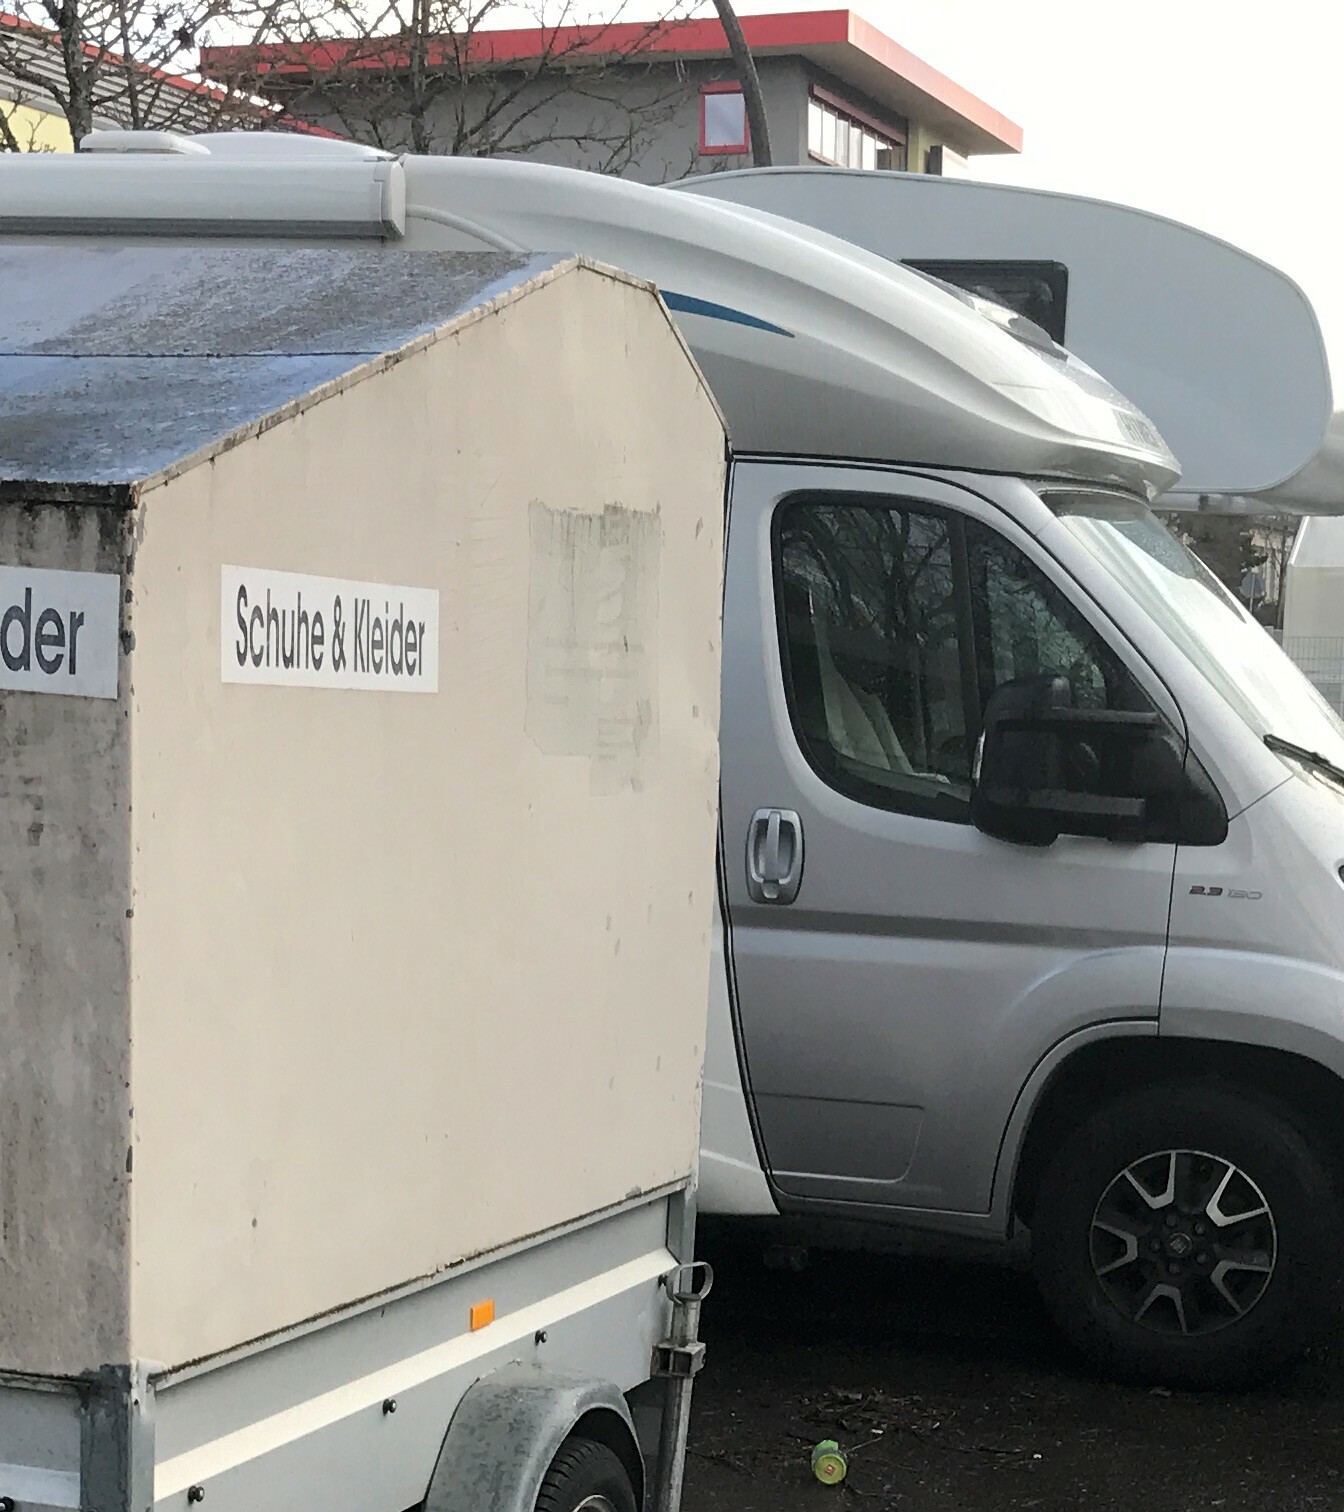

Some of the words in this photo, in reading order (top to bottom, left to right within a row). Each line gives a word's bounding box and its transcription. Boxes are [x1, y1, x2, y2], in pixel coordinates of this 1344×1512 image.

[235, 583, 325, 672] Schuhe
[331, 594, 347, 673] &
[353, 597, 426, 677] Kleider
